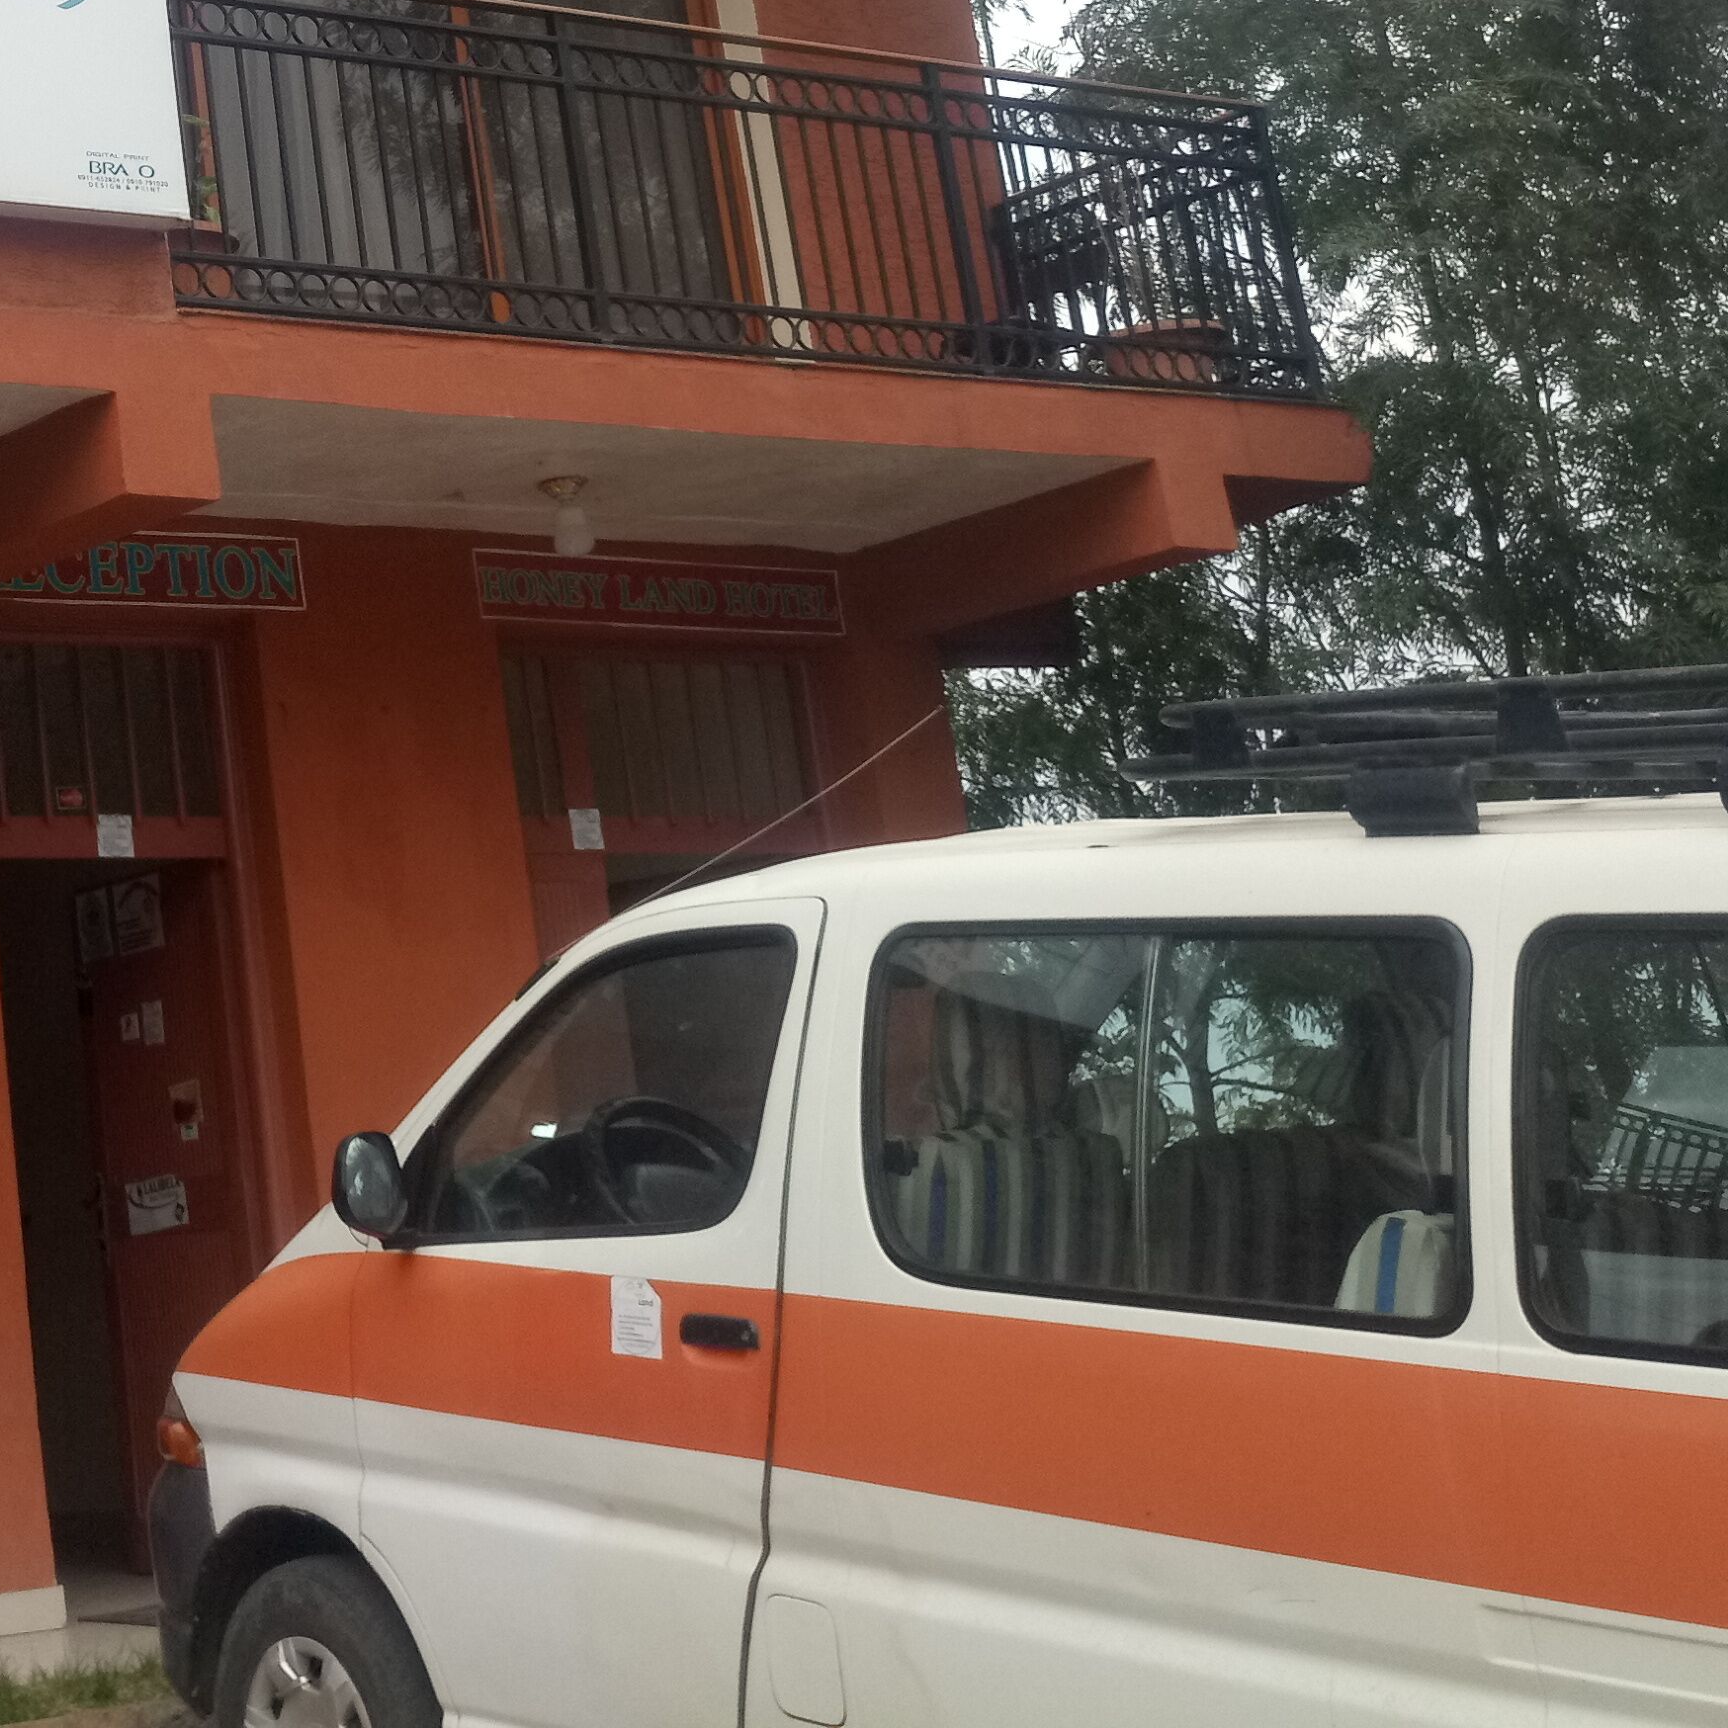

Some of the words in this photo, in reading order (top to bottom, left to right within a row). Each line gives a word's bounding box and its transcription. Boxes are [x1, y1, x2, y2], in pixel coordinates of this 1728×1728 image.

[479, 565, 609, 610] HONEY
[618, 574, 716, 615] LAND
[724, 580, 838, 621] HOTEL
